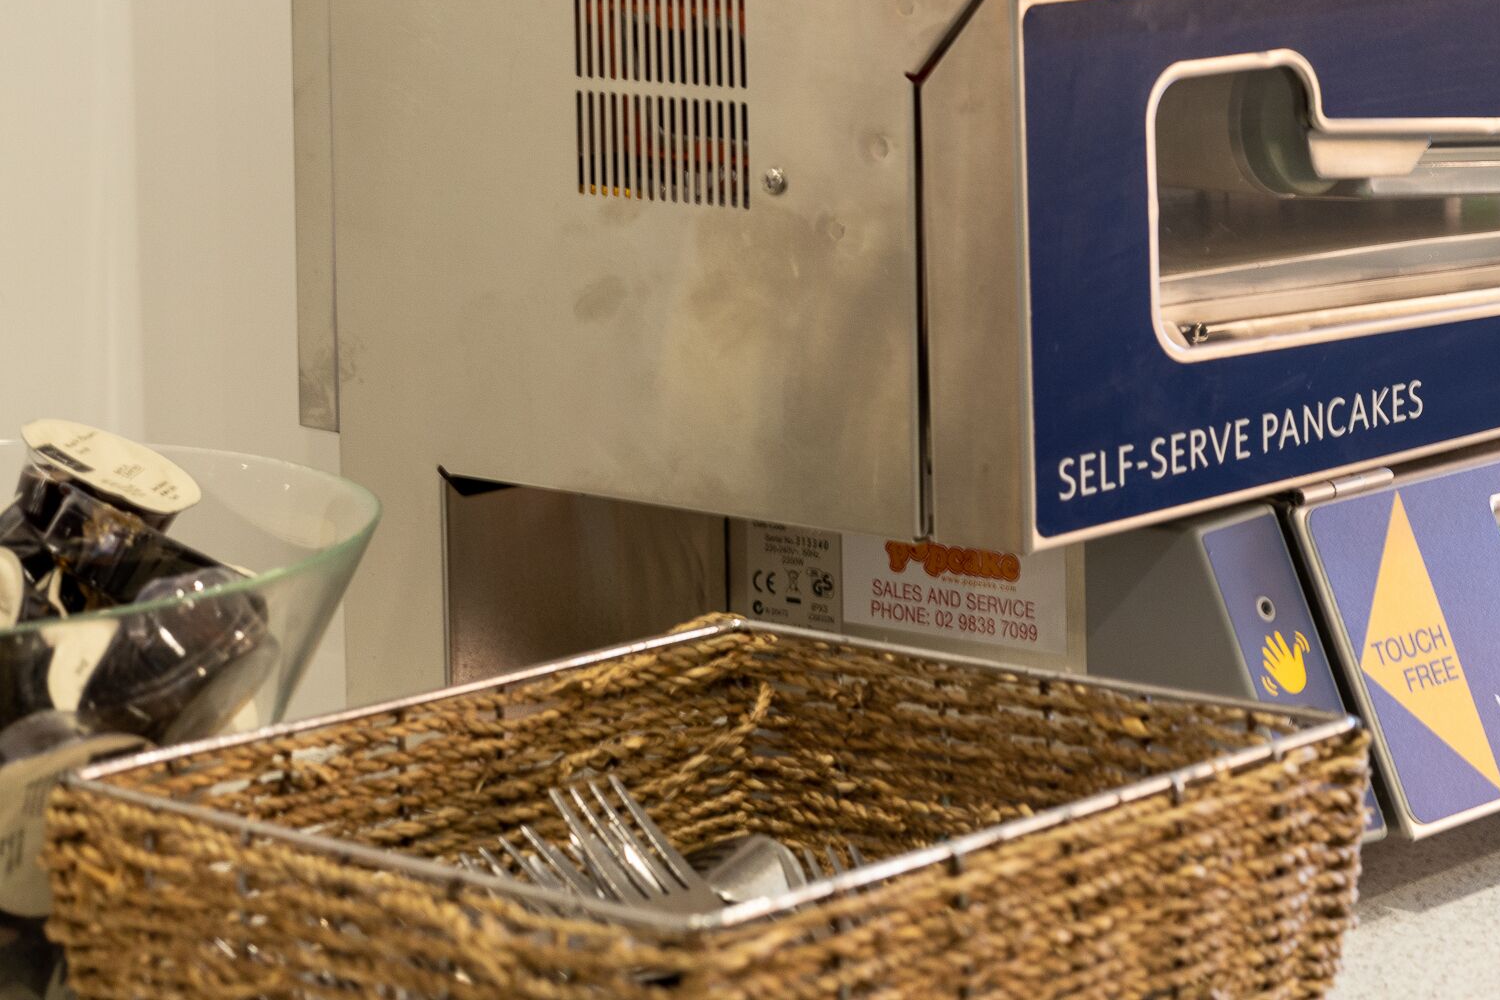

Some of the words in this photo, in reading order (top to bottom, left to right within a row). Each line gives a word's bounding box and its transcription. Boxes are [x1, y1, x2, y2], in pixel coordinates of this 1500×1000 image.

[1058, 417, 1250, 501] SELF-SERVE
[1262, 379, 1424, 454] PANCAKES
[872, 578, 923, 602] SALES
[927, 587, 961, 609] AND
[966, 592, 1035, 620] SERVICE
[871, 600, 930, 626] PHONE:
[935, 609, 954, 629] 02
[958, 613, 996, 636] 9838
[1000, 619, 1038, 643] 7099
[1370, 624, 1447, 667] TOUCH
[1403, 657, 1460, 694] FREE
